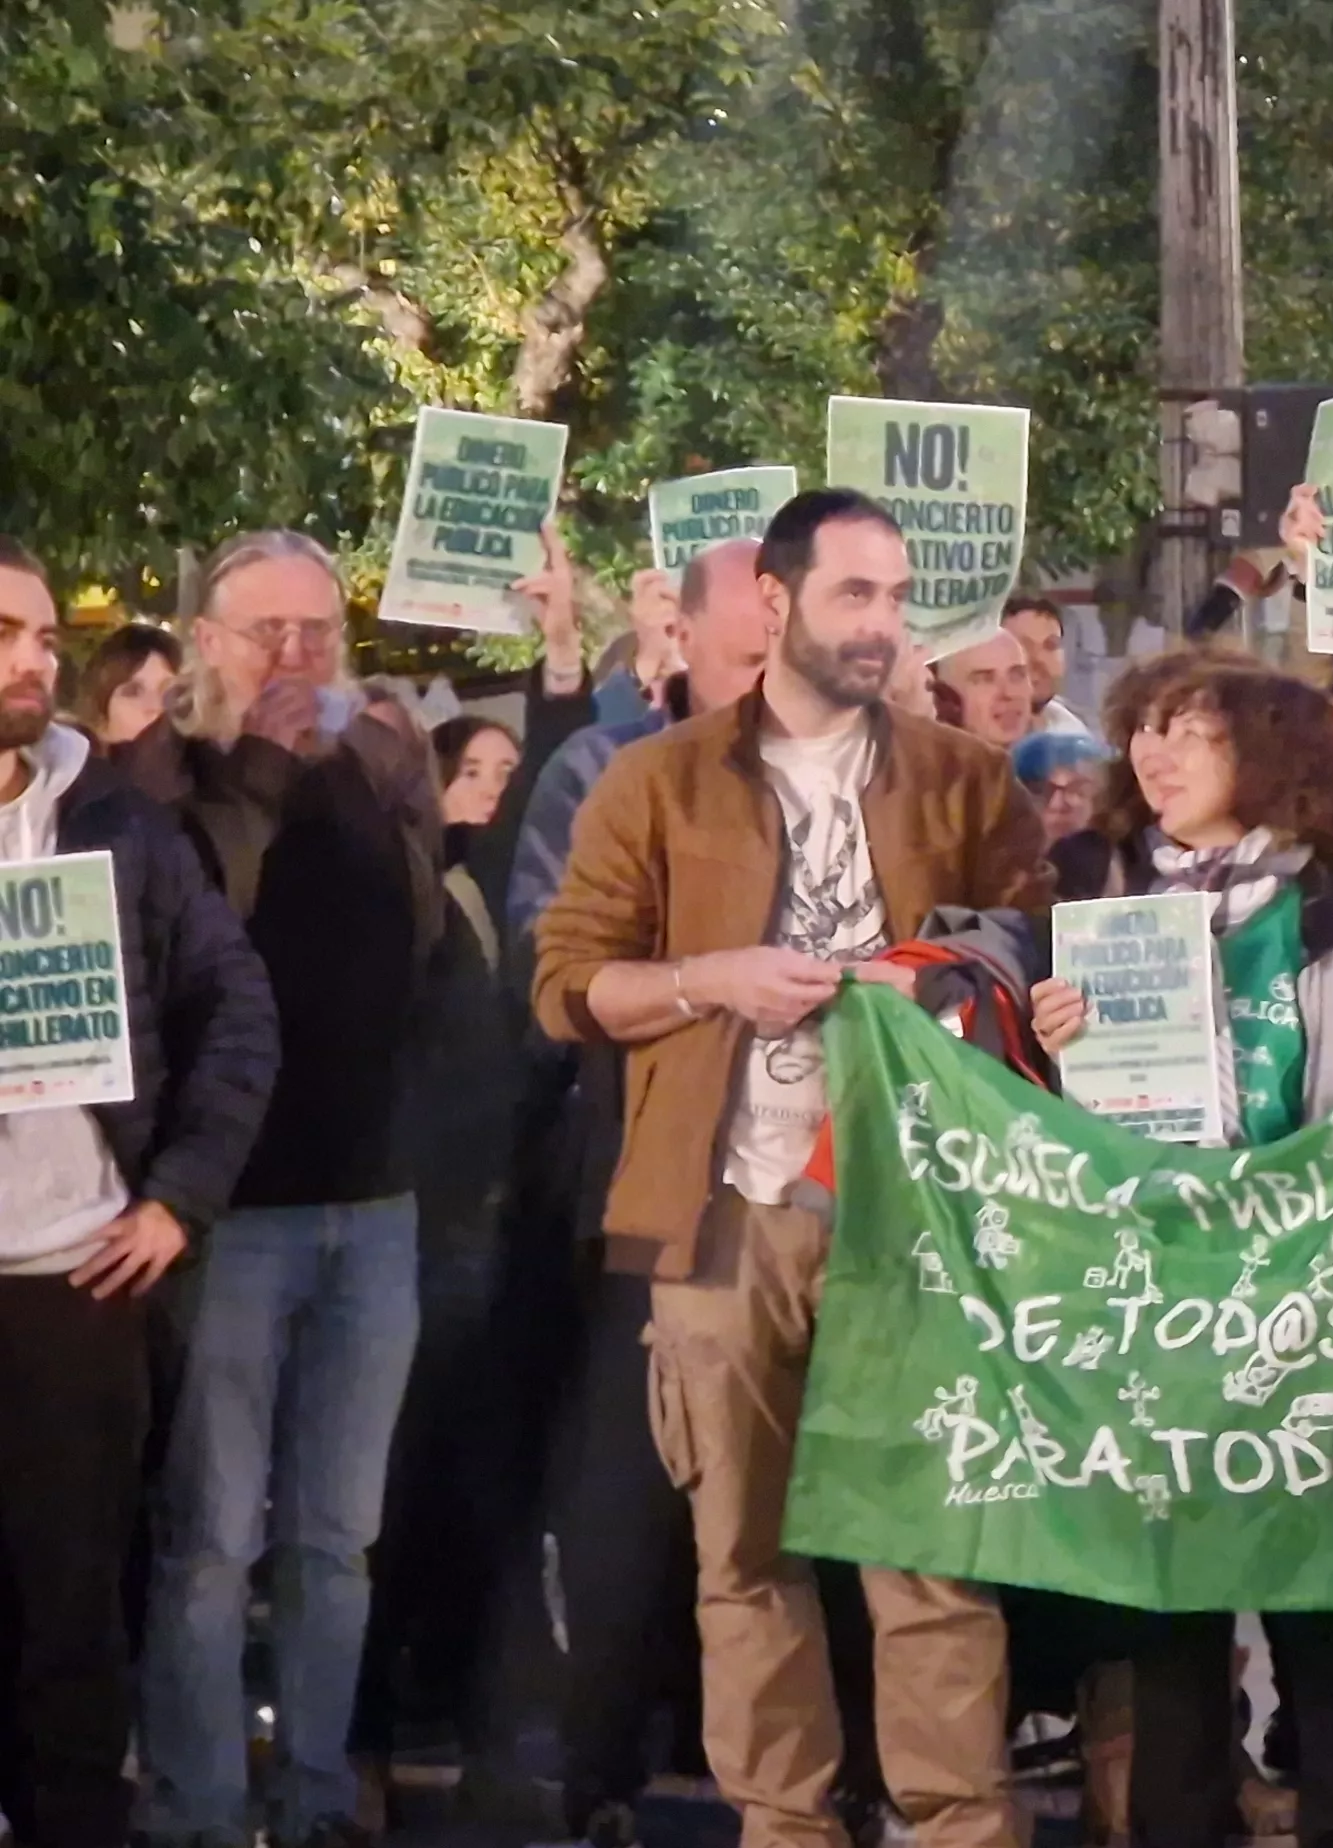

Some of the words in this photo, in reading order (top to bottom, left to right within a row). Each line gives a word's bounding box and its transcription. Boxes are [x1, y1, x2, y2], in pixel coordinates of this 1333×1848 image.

[884, 421, 970, 492] NO!
[907, 538, 974, 572] ATIVO
[981, 541, 1013, 570] EN
[910, 573, 1009, 609] LLERATO
[85, 976, 117, 1006] EN
[898, 1112, 1155, 1226] ESCUELA
[960, 1295, 1061, 1362] DE
[944, 1413, 1134, 1493] PARA
